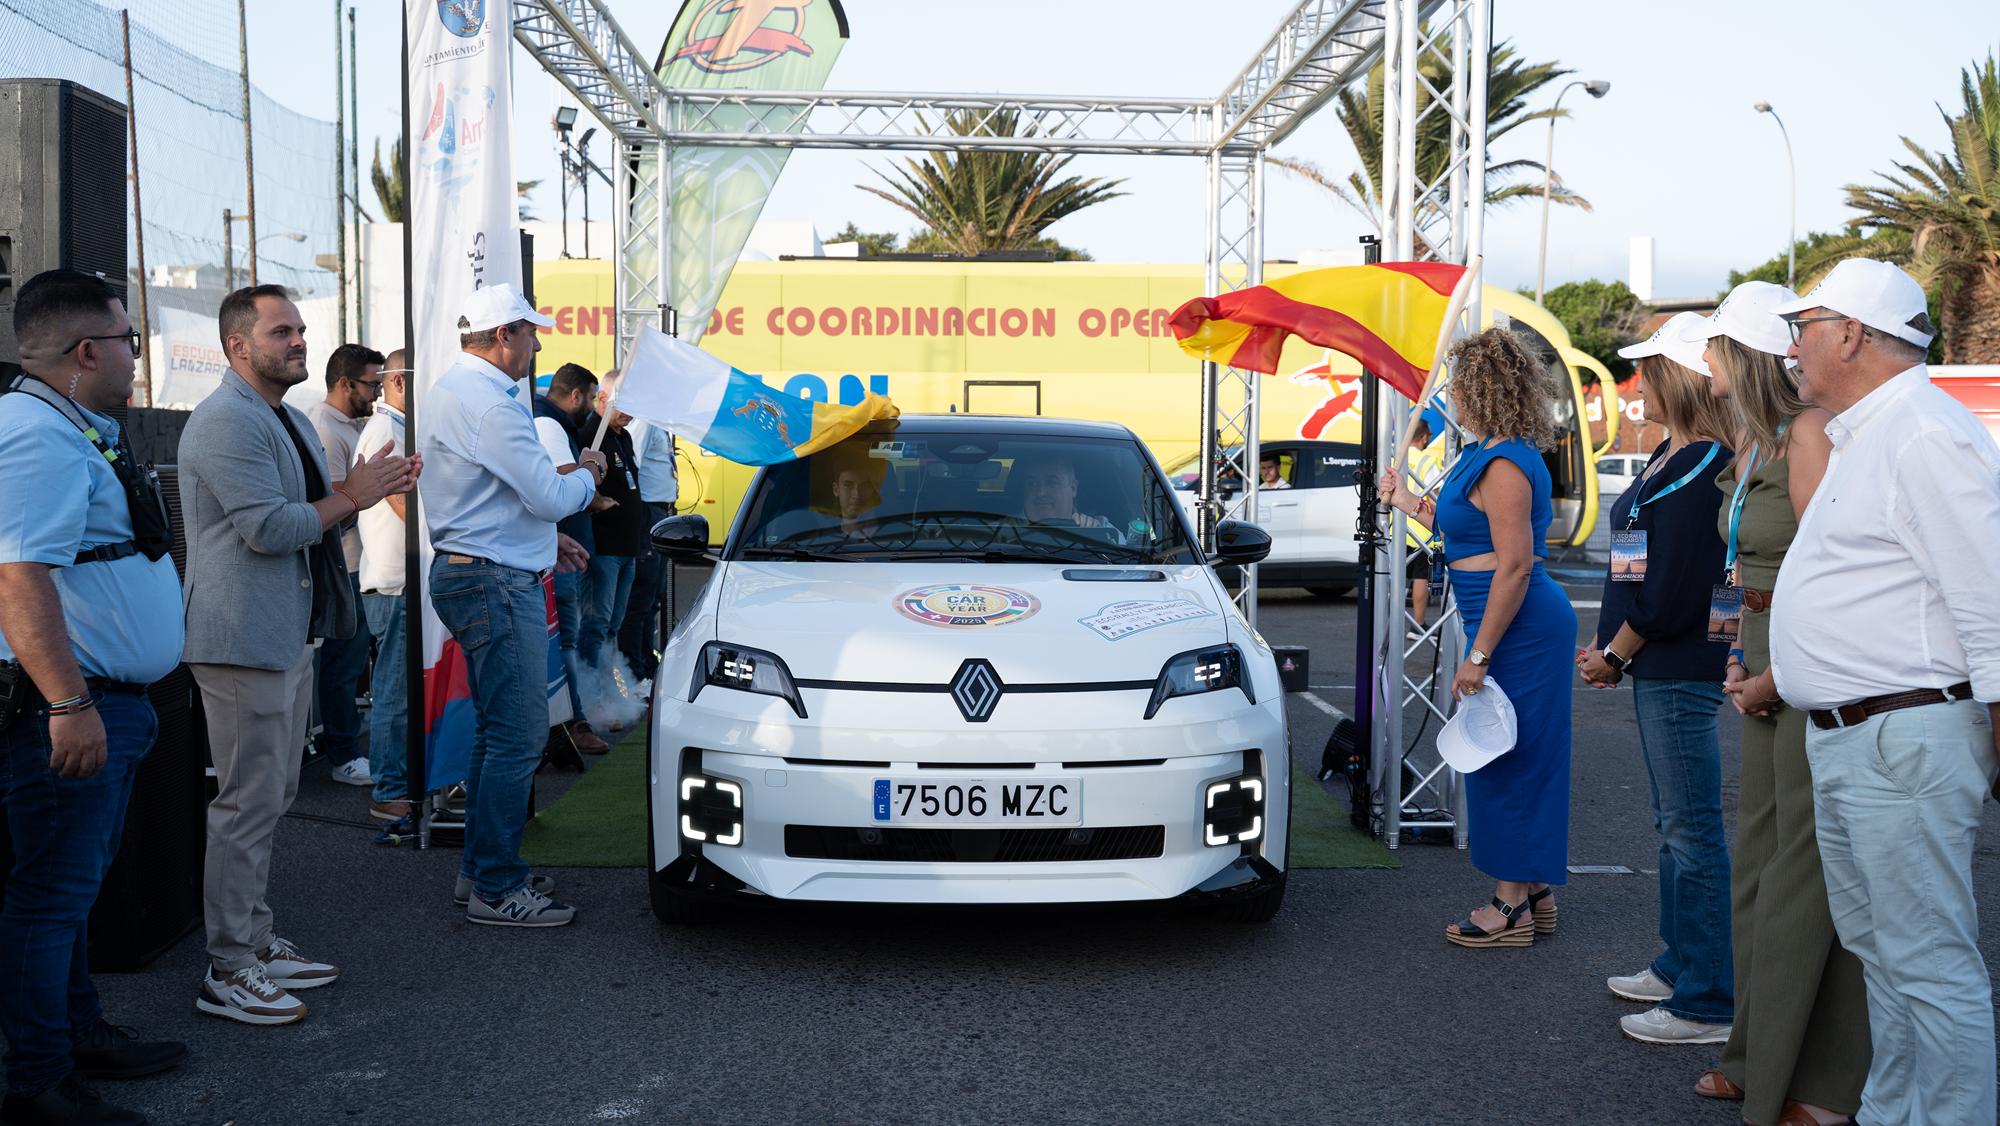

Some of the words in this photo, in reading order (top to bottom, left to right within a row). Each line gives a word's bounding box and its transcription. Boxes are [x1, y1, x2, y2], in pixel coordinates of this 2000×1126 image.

[537, 305, 616, 336] CENT
[766, 306, 1056, 338] COORDINACION
[1078, 307, 1173, 338] OPER
[946, 595, 986, 604] CAR
[954, 617, 982, 625] 2025
[879, 804, 886, 814] E
[897, 784, 988, 817] 7506
[1002, 784, 1069, 817] MZC
